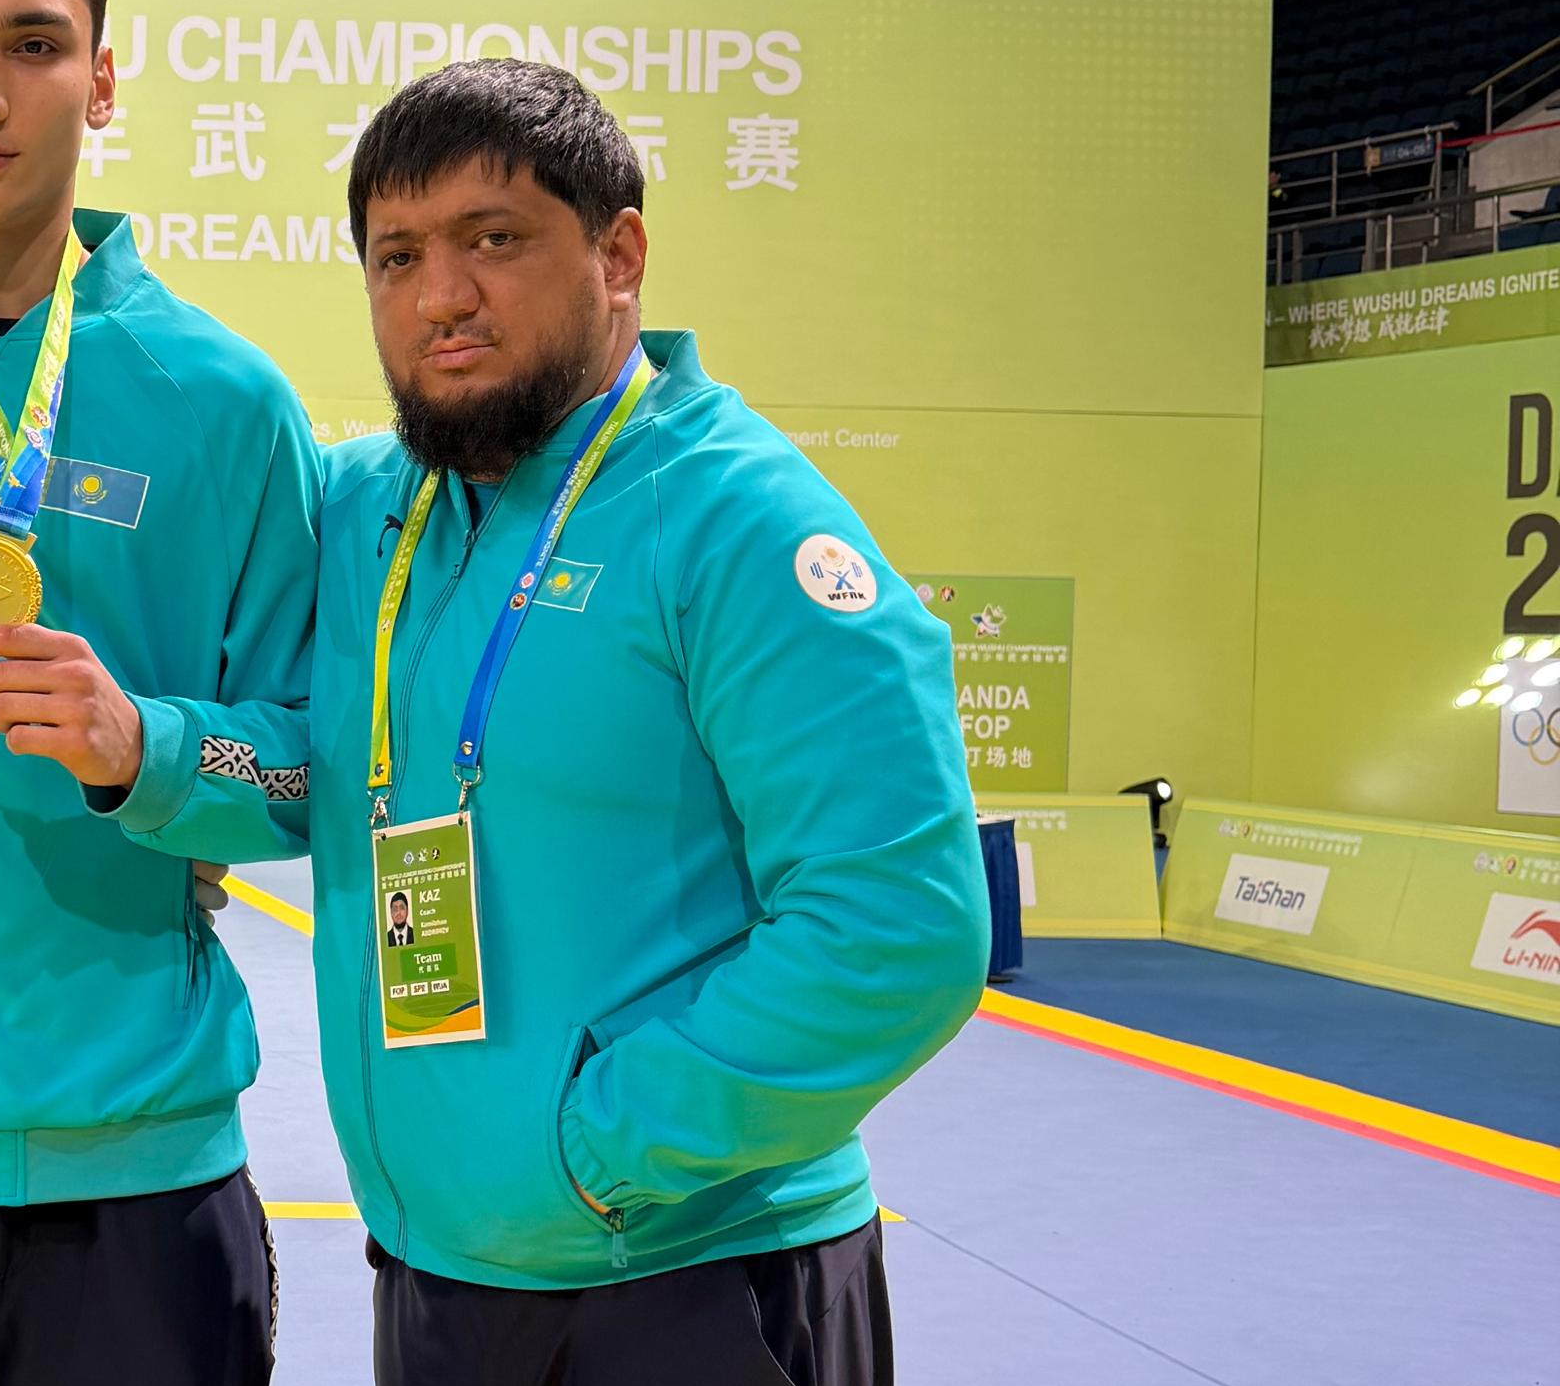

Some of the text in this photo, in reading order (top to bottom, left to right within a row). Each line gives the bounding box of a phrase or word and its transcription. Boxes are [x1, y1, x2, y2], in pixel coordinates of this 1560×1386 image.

[166, 15, 804, 97] CHAMPIONSHIPS
[1288, 298, 1349, 326] WHERE
[1352, 289, 1417, 315] WUSHU
[1421, 278, 1496, 307] DREAMS
[1500, 268, 1560, 296] IGNITE
[834, 428, 899, 448] Center
[957, 685, 1031, 710] ANDA
[961, 714, 1011, 739] FOP
[419, 888, 441, 904] KAZ
[1235, 876, 1307, 912] TaiShan
[414, 952, 443, 965] Team
[1502, 946, 1560, 974] LI-NIN
